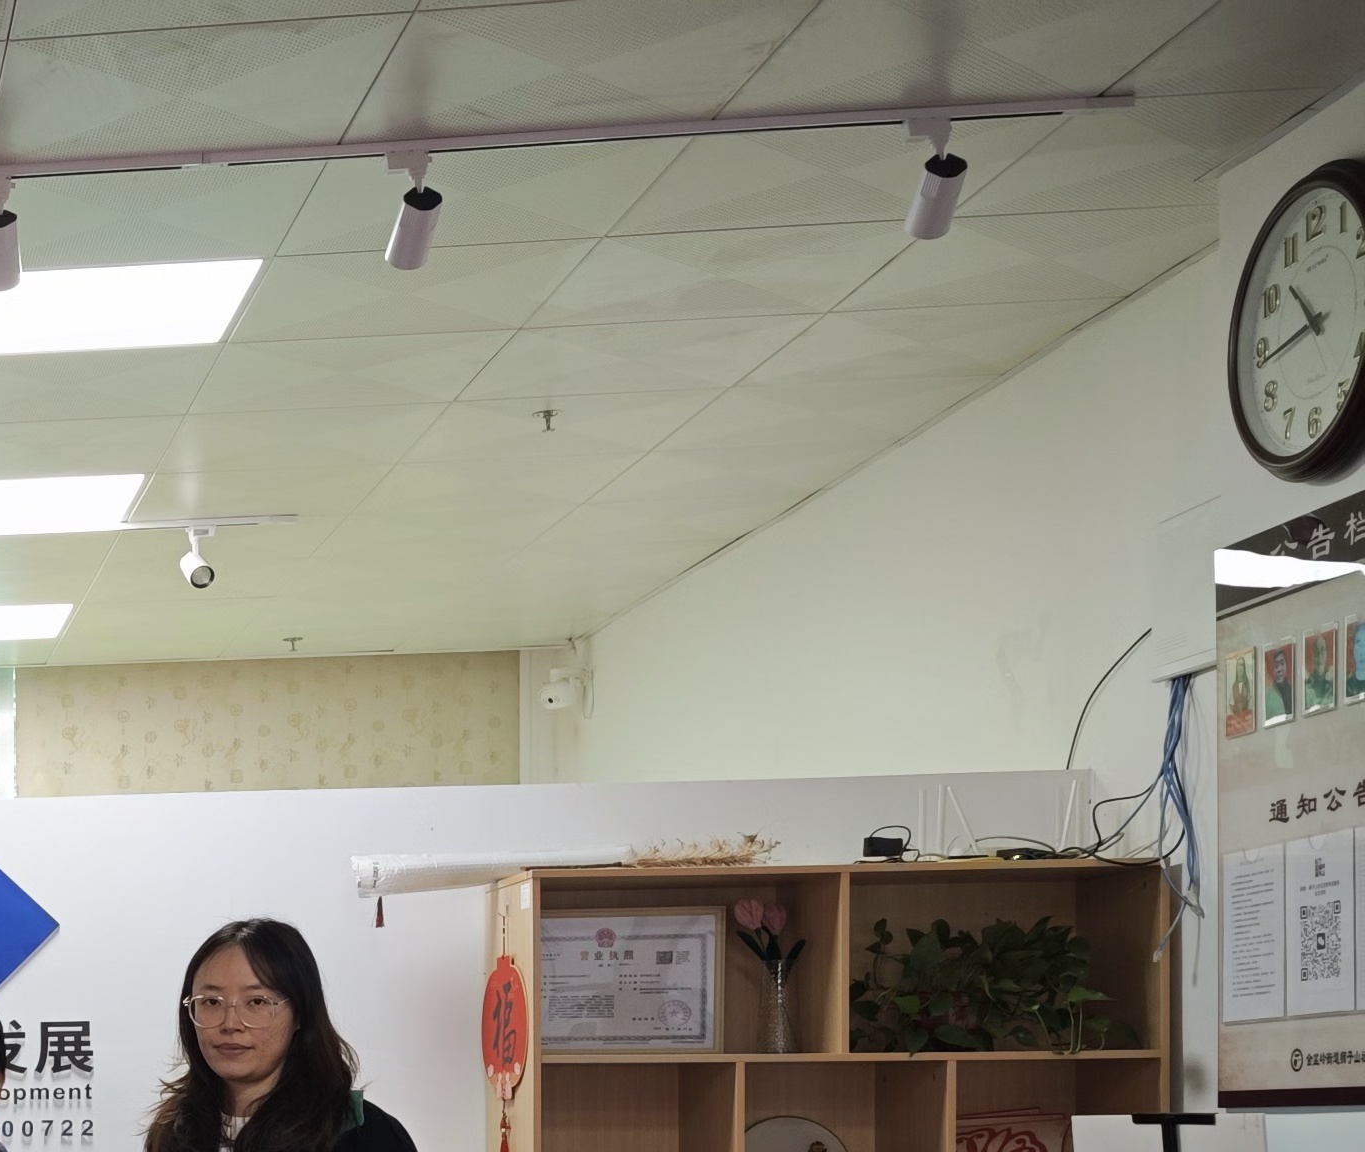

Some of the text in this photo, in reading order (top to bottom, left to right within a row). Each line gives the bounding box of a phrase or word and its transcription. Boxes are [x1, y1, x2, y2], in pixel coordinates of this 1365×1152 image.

[1305, 204, 1327, 243] 12
[1283, 231, 1299, 269] 11
[1262, 283, 1281, 319] 10
[1256, 337, 1271, 369] 9
[1263, 380, 1279, 412] 8
[1282, 406, 1297, 440] 7
[1307, 406, 1322, 439] 6
